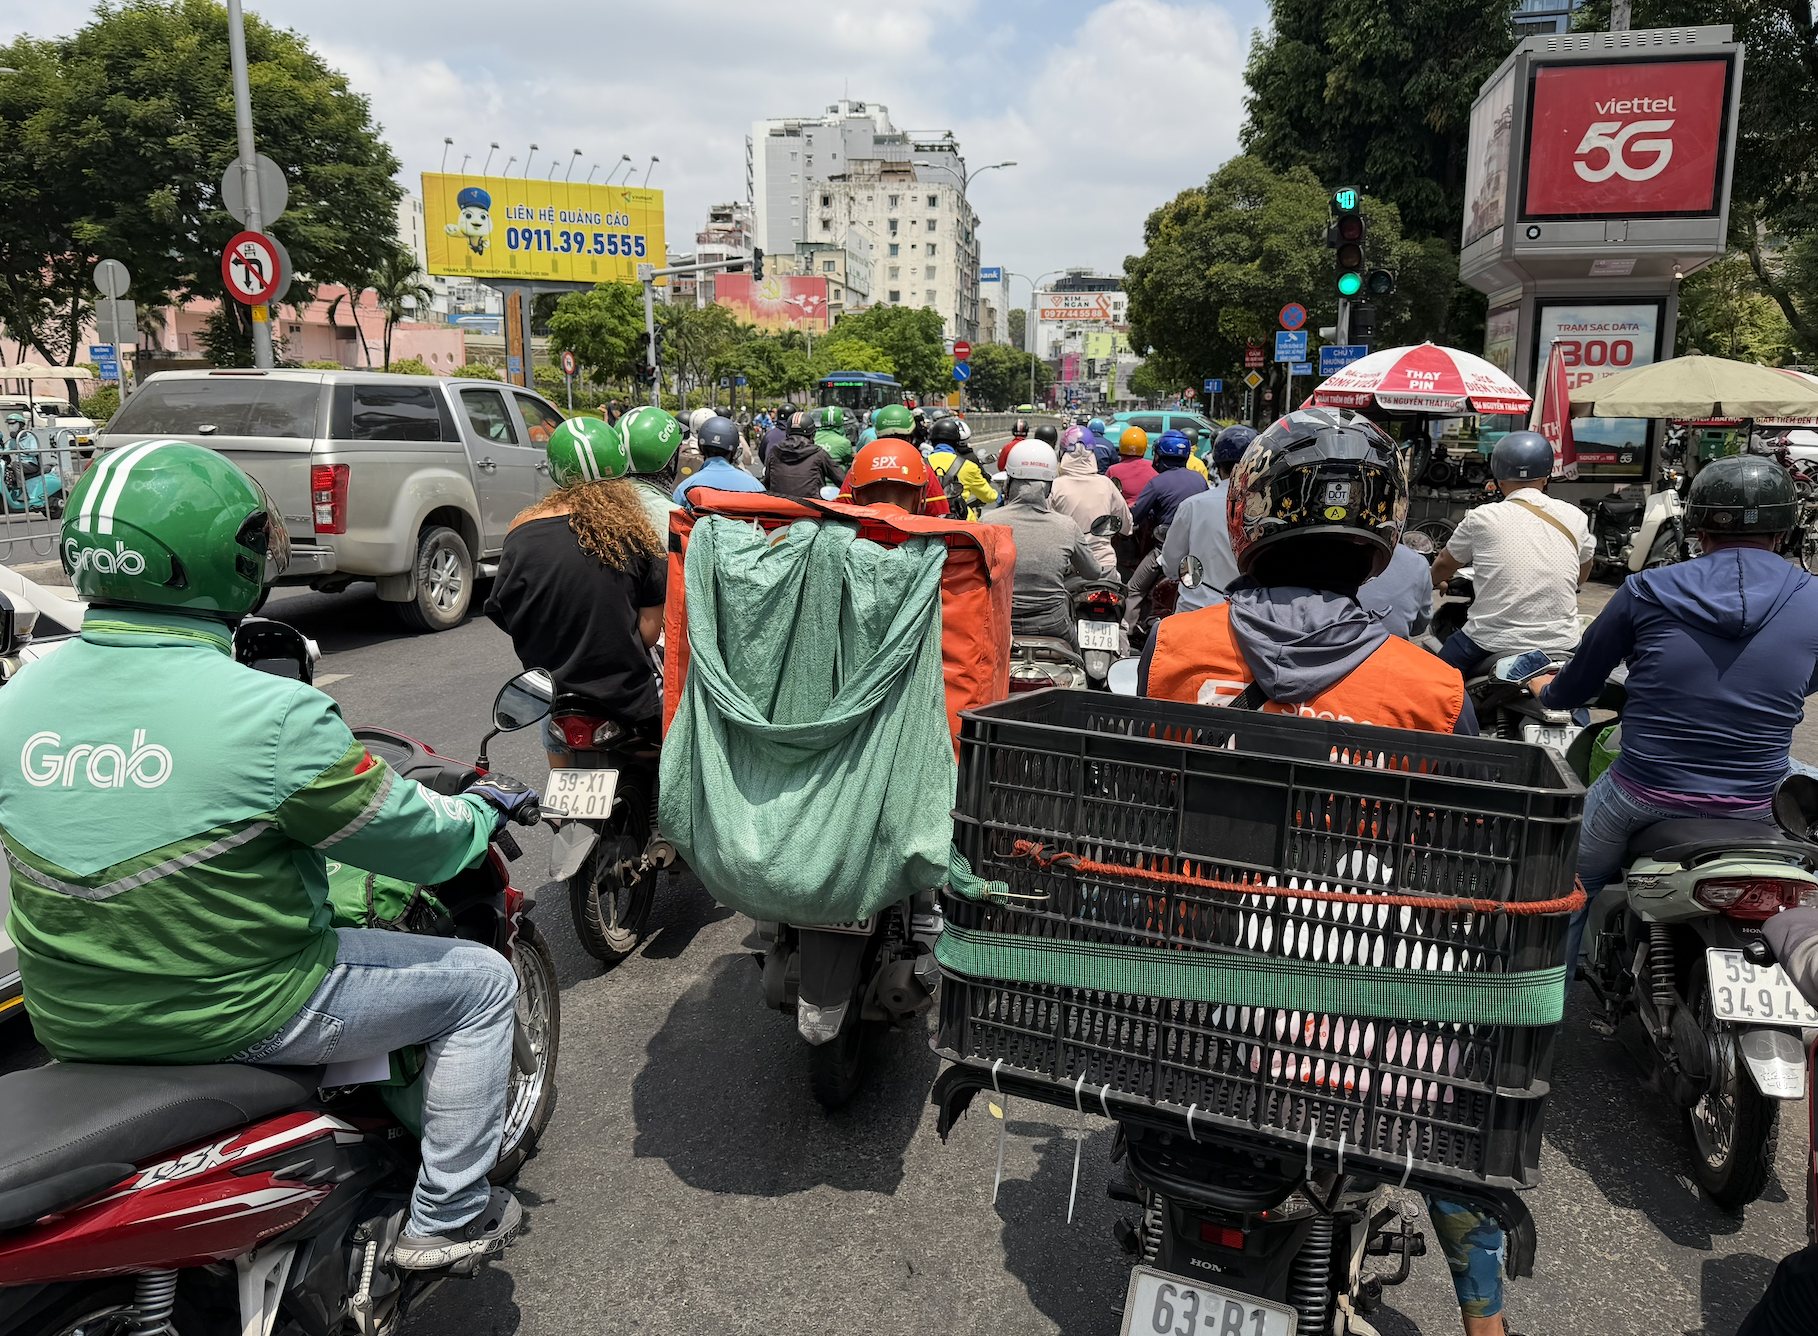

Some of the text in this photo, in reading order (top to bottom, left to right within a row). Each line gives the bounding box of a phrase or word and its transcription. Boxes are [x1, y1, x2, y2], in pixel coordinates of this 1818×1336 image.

[1595, 96, 1677, 115] viettel
[1573, 119, 1675, 183] 5G
[1336, 190, 1355, 210] 40
[506, 204, 534, 220] LIÊN
[539, 206, 555, 226] HỆ
[606, 211, 630, 227] CÁO
[506, 227, 646, 257] 0911.39.5555
[1557, 323, 1639, 332] TRẠM SẠC DATA
[1561, 340, 1634, 367] 300
[1325, 377, 1354, 387] SINH
[1406, 369, 1441, 380] THAY
[1409, 380, 1434, 390] PIN
[1393, 396, 1423, 406] NGUYỄN
[1425, 398, 1442, 407] THÁI
[658, 418, 677, 443] Grab
[872, 456, 897, 467] SPX
[1329, 491, 1346, 499] DOT
[1331, 509, 1339, 518] A
[65, 537, 145, 576] Grab
[1084, 635, 1113, 648] 3478
[20, 728, 173, 789] Grab
[558, 772, 605, 793] 59-X1
[1189, 1257, 1222, 1273] HON
